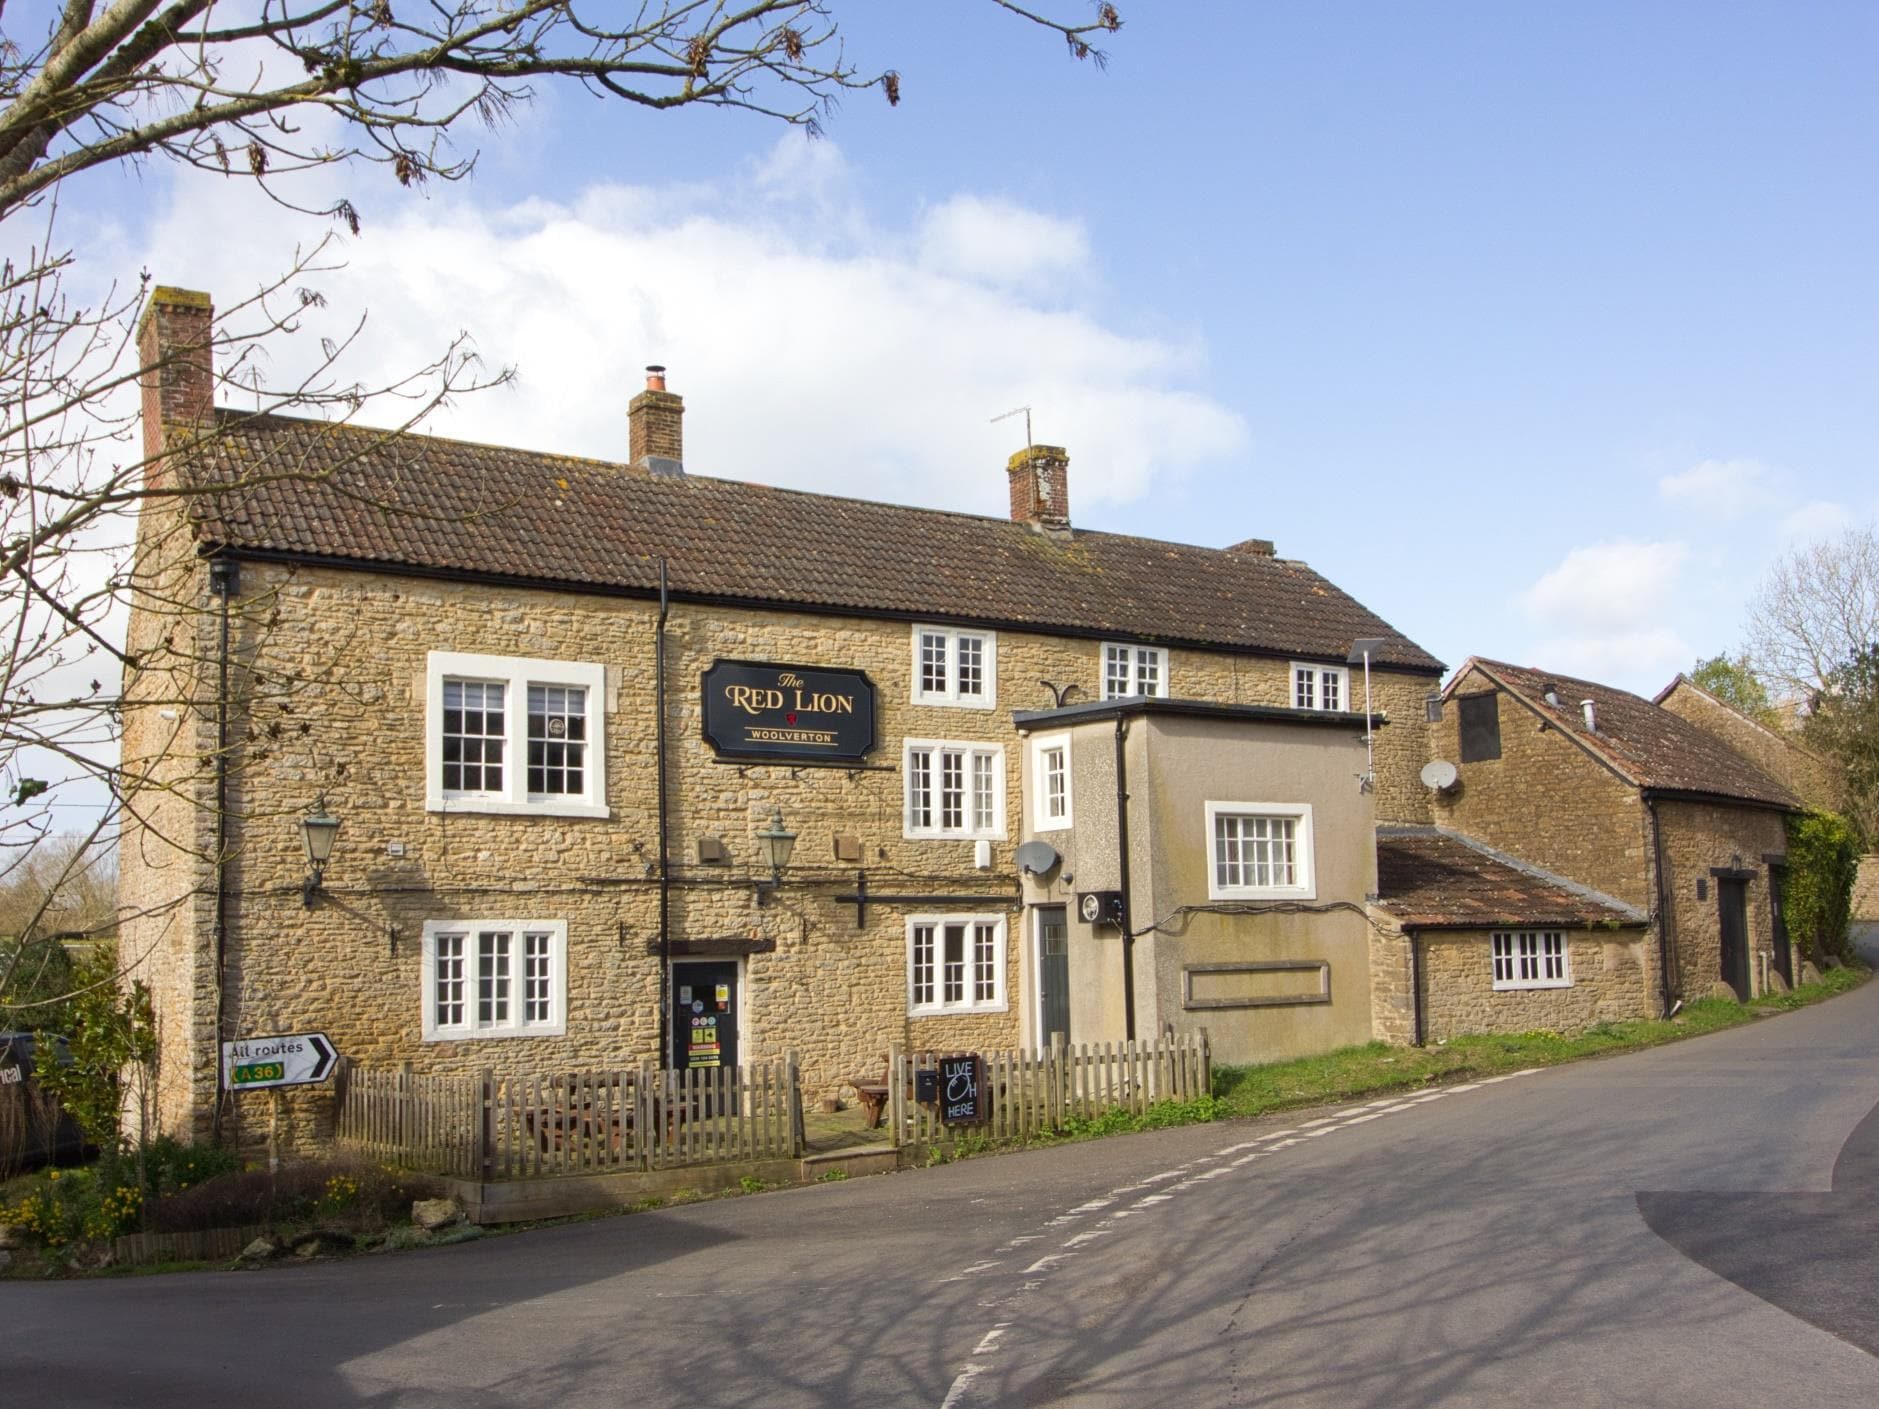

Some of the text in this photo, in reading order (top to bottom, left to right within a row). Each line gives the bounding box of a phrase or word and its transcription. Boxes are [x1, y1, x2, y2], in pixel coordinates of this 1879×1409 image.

[777, 672, 804, 688] The
[725, 685, 854, 715] RED LION
[751, 730, 832, 742] WOOLVERTON
[255, 1042, 304, 1056] routes
[945, 1061, 973, 1078] LIVE
[947, 1101, 974, 1118] HERE
